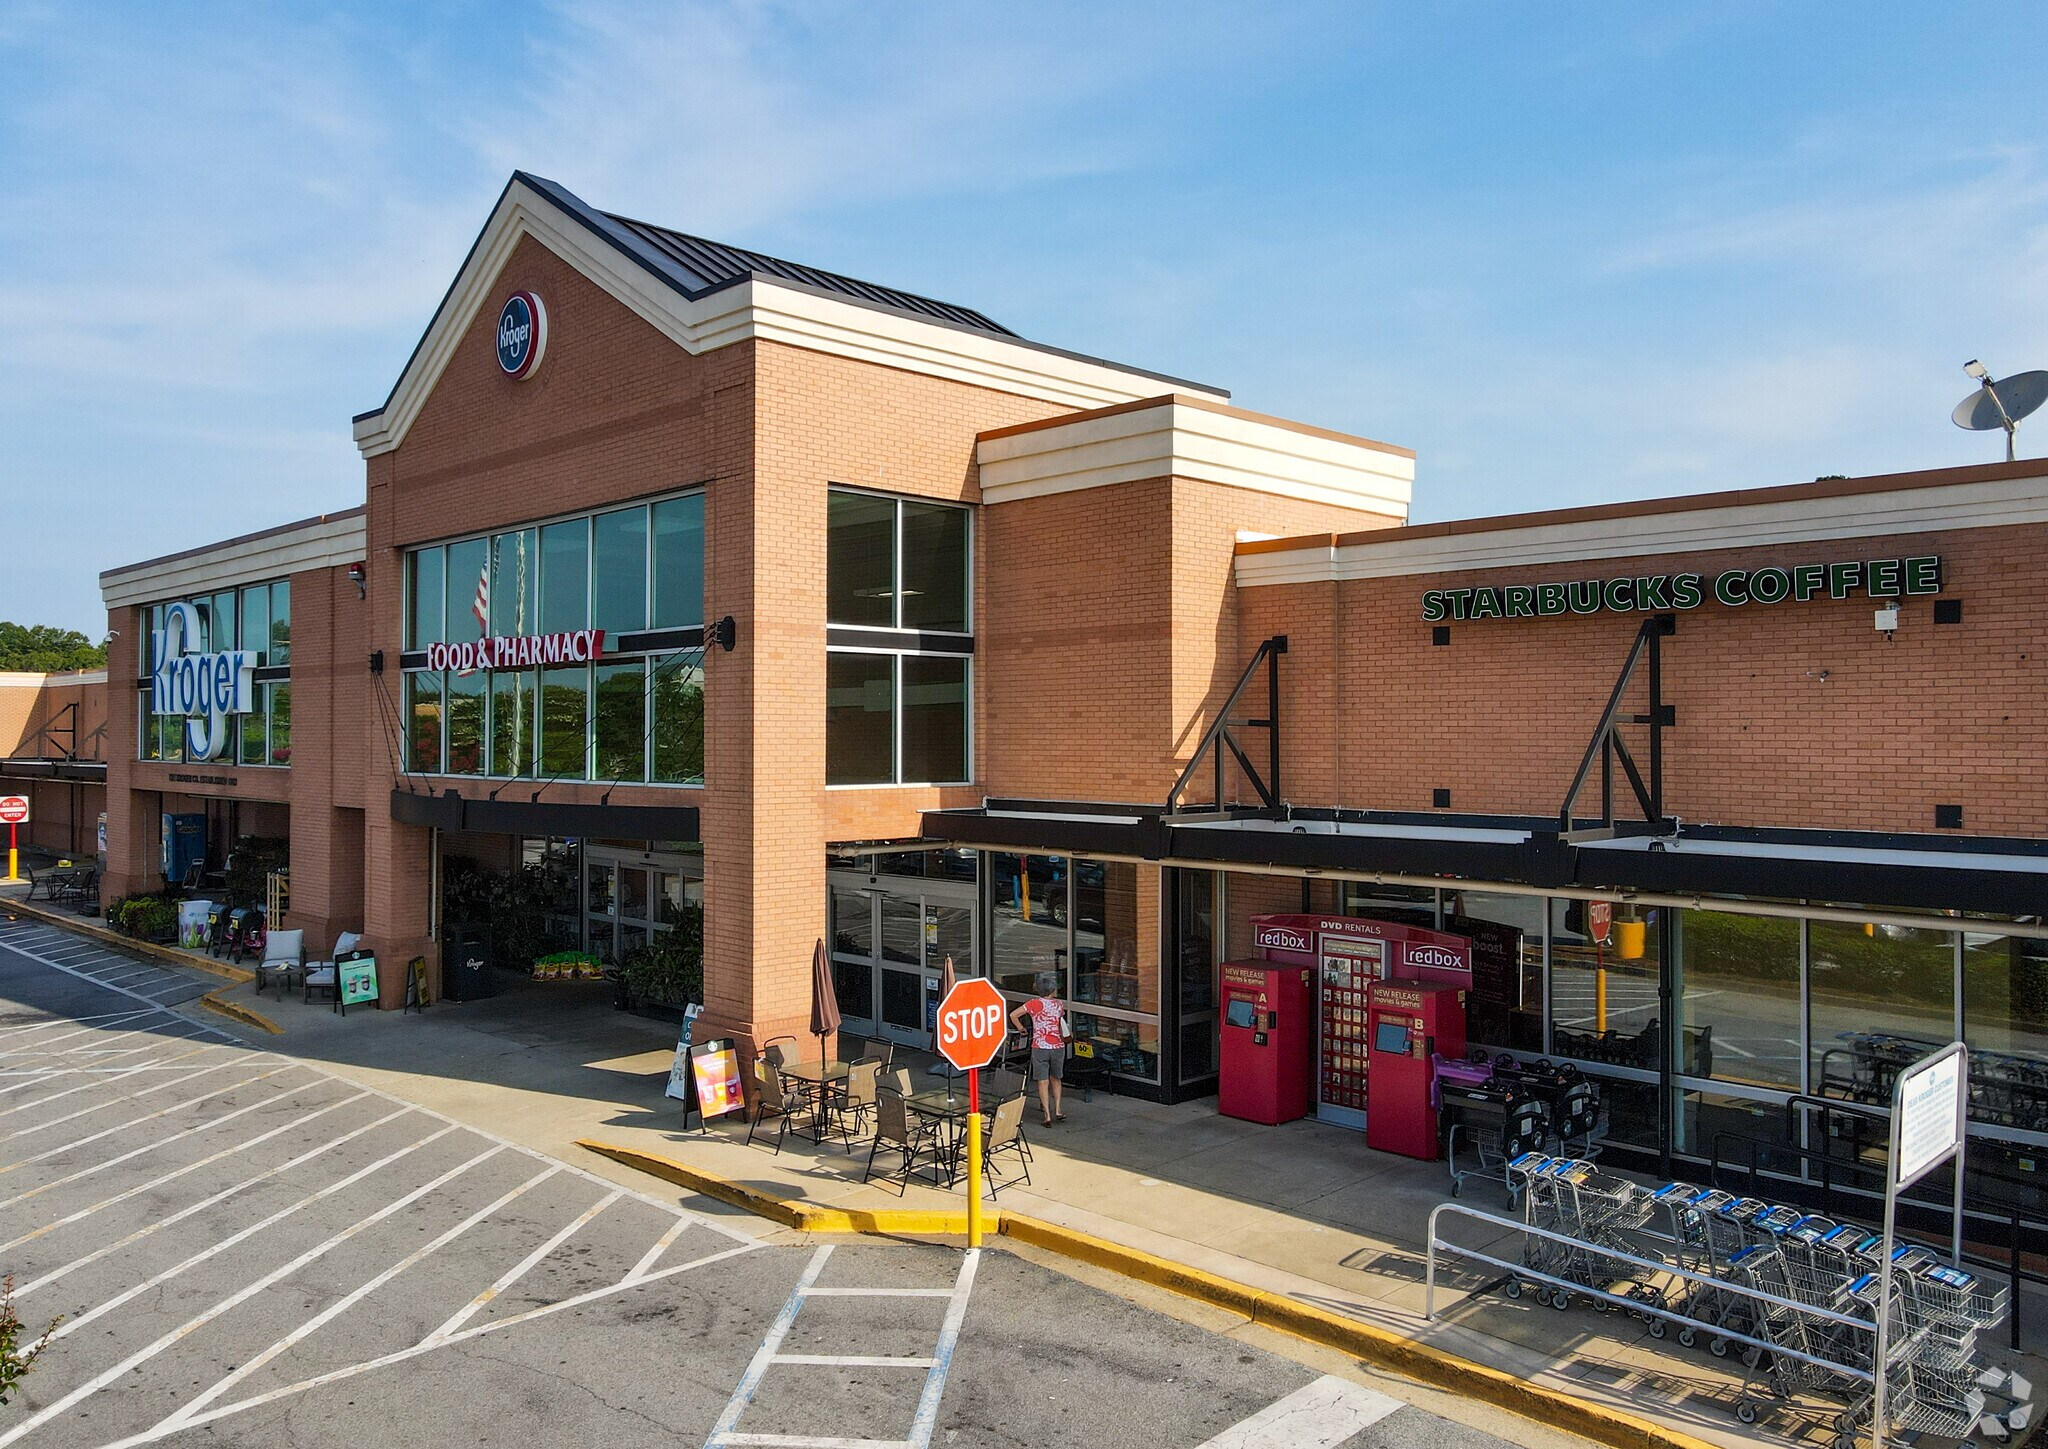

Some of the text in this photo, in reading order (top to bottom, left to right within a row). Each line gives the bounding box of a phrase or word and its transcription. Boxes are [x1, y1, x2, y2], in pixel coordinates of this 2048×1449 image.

[500, 314, 529, 358] Kroger
[1421, 556, 1941, 622] STARBUCKS COFFEE
[427, 630, 597, 671] FOOD & PHARMACY
[152, 602, 253, 760] Kroger
[1320, 921, 1381, 935] DVD RENTALS
[1260, 932, 1305, 949] redbox
[1480, 932, 1498, 942] NEW
[1410, 949, 1463, 968] redbox
[1225, 968, 1265, 980] NEW RELEASE
[1225, 975, 1243, 983] movies
[1247, 978, 1265, 986] games
[1258, 992, 1267, 1003] A
[1373, 989, 1420, 1001] NEW RELEASE
[1374, 996, 1395, 1005] movies
[1400, 1000, 1420, 1008] games
[943, 1004, 1001, 1044] STOP
[1414, 1018, 1424, 1030] B
